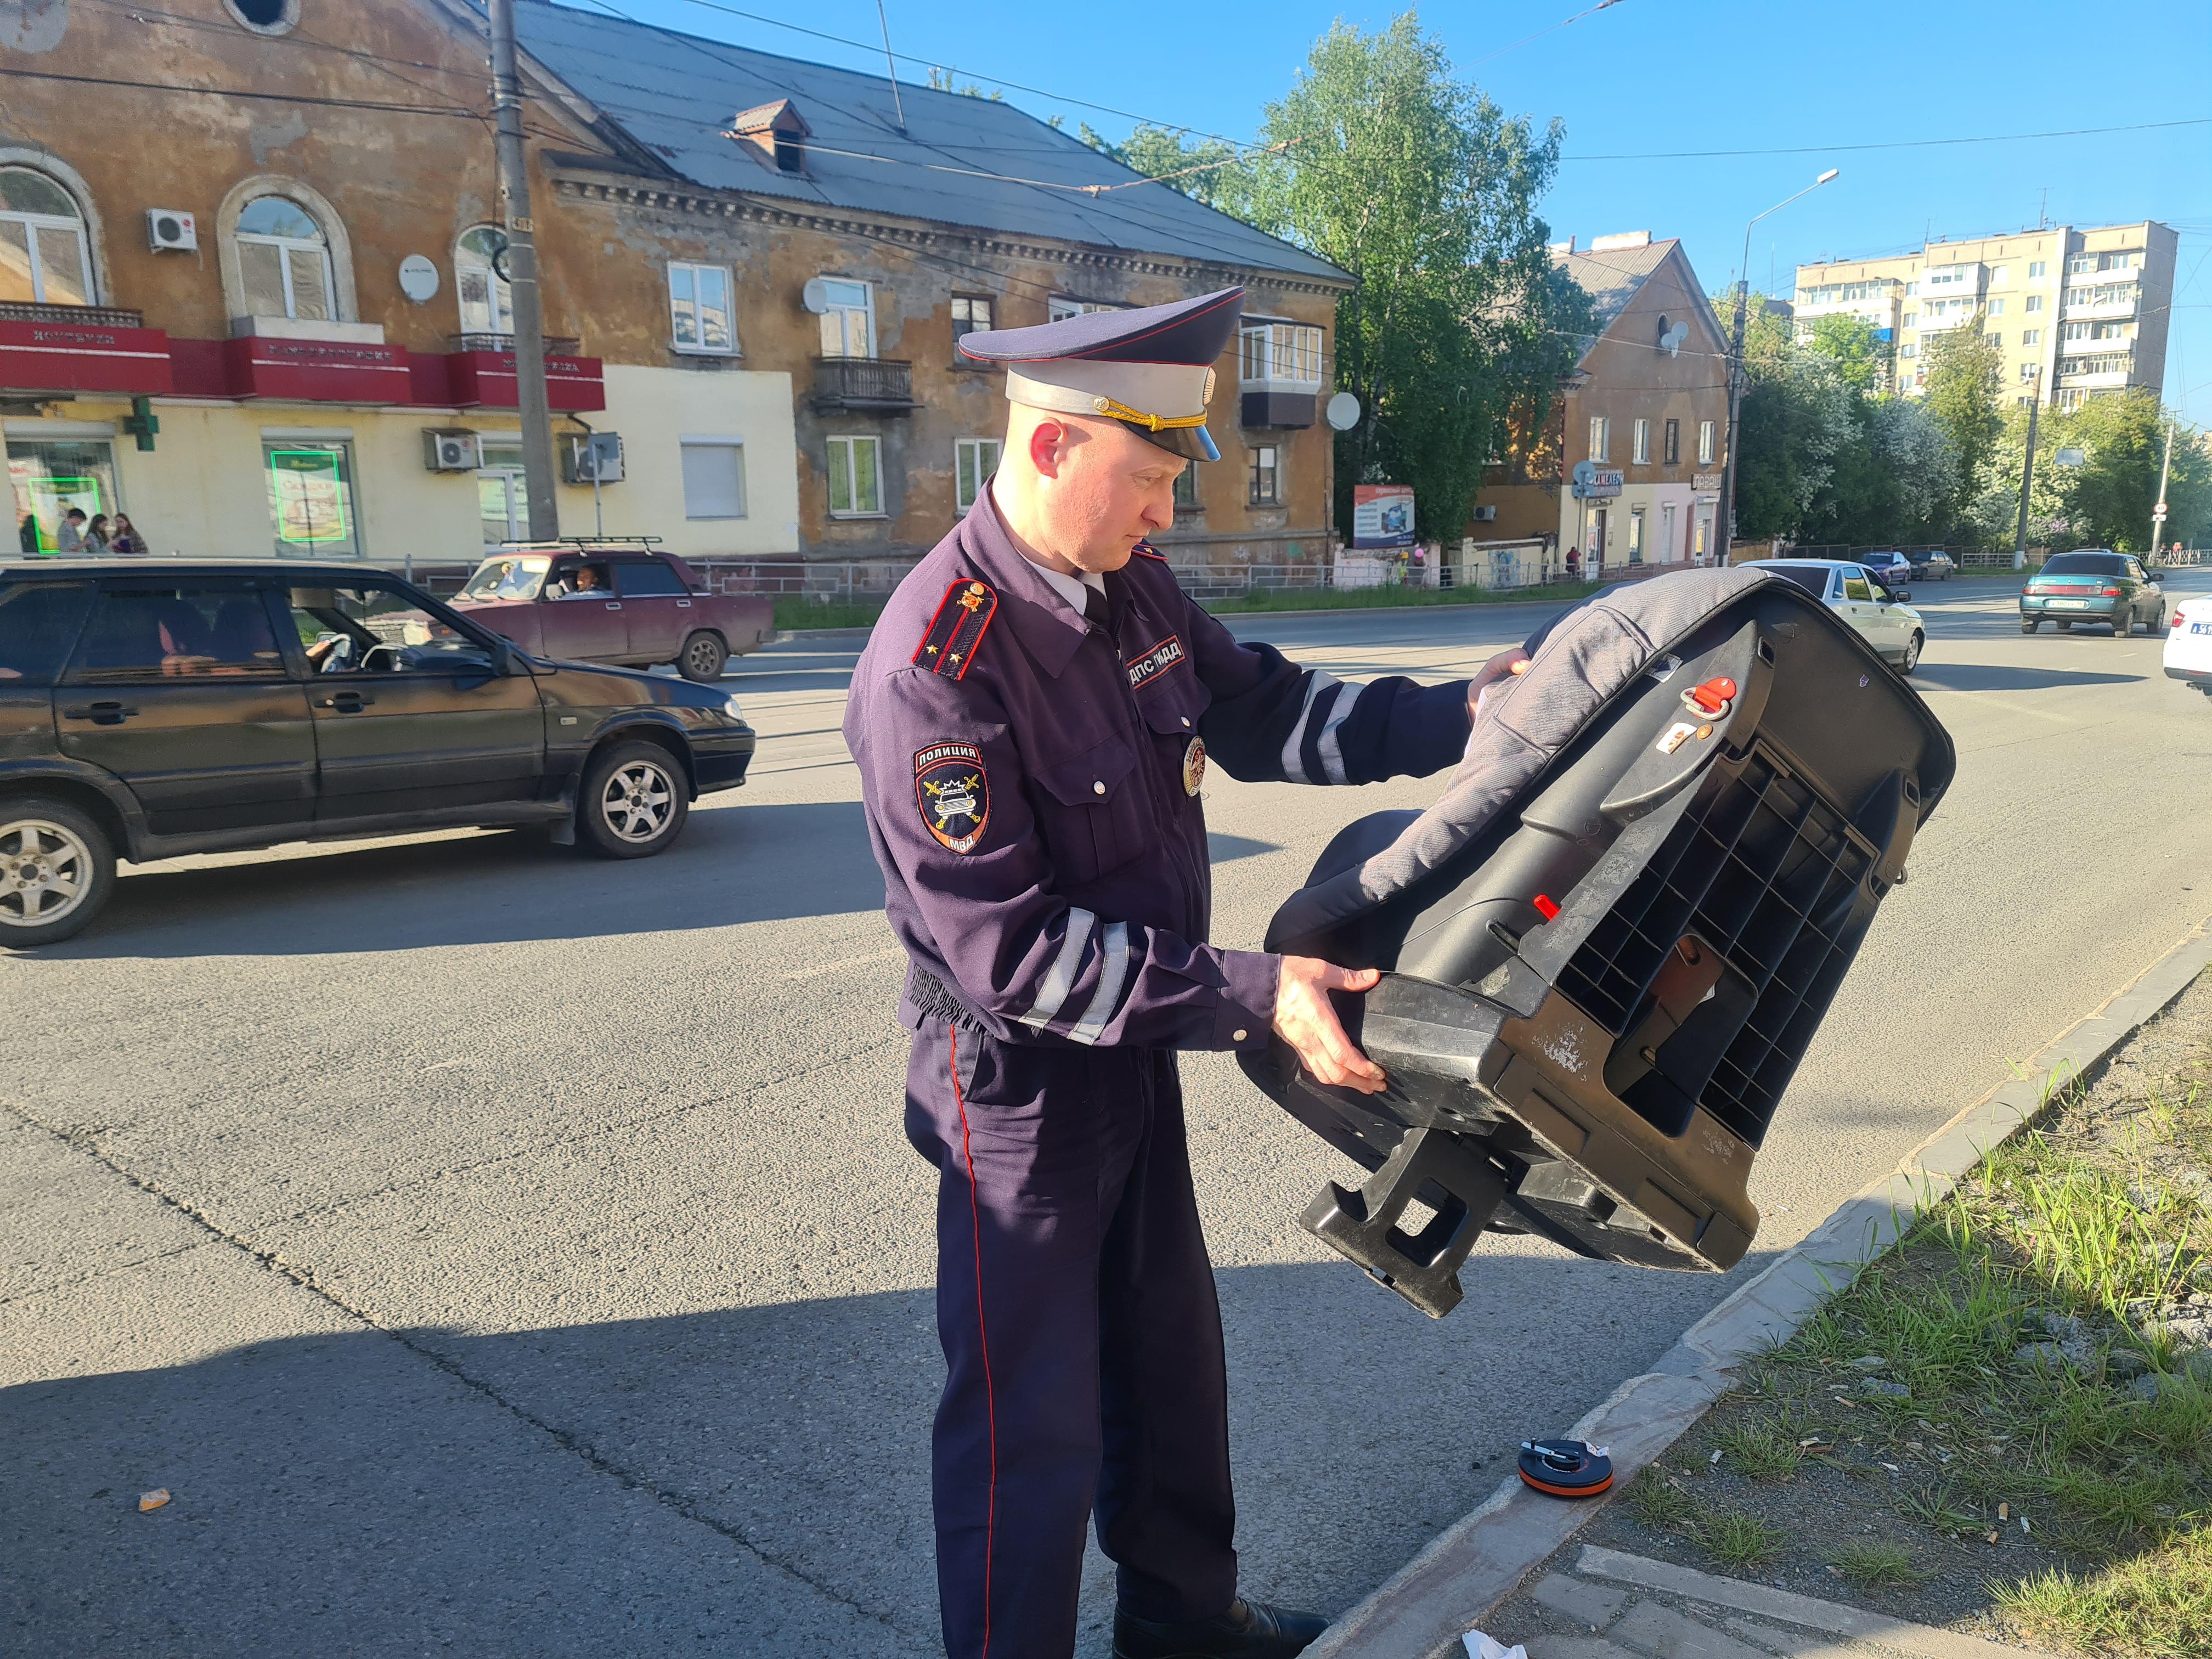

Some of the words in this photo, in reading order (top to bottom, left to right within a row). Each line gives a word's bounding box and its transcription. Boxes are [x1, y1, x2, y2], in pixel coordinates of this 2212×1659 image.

[1129, 660, 1154, 685] ДПС
[919, 746, 977, 766] ПОЛИЦИЯ
[950, 834, 974, 851] МВД
